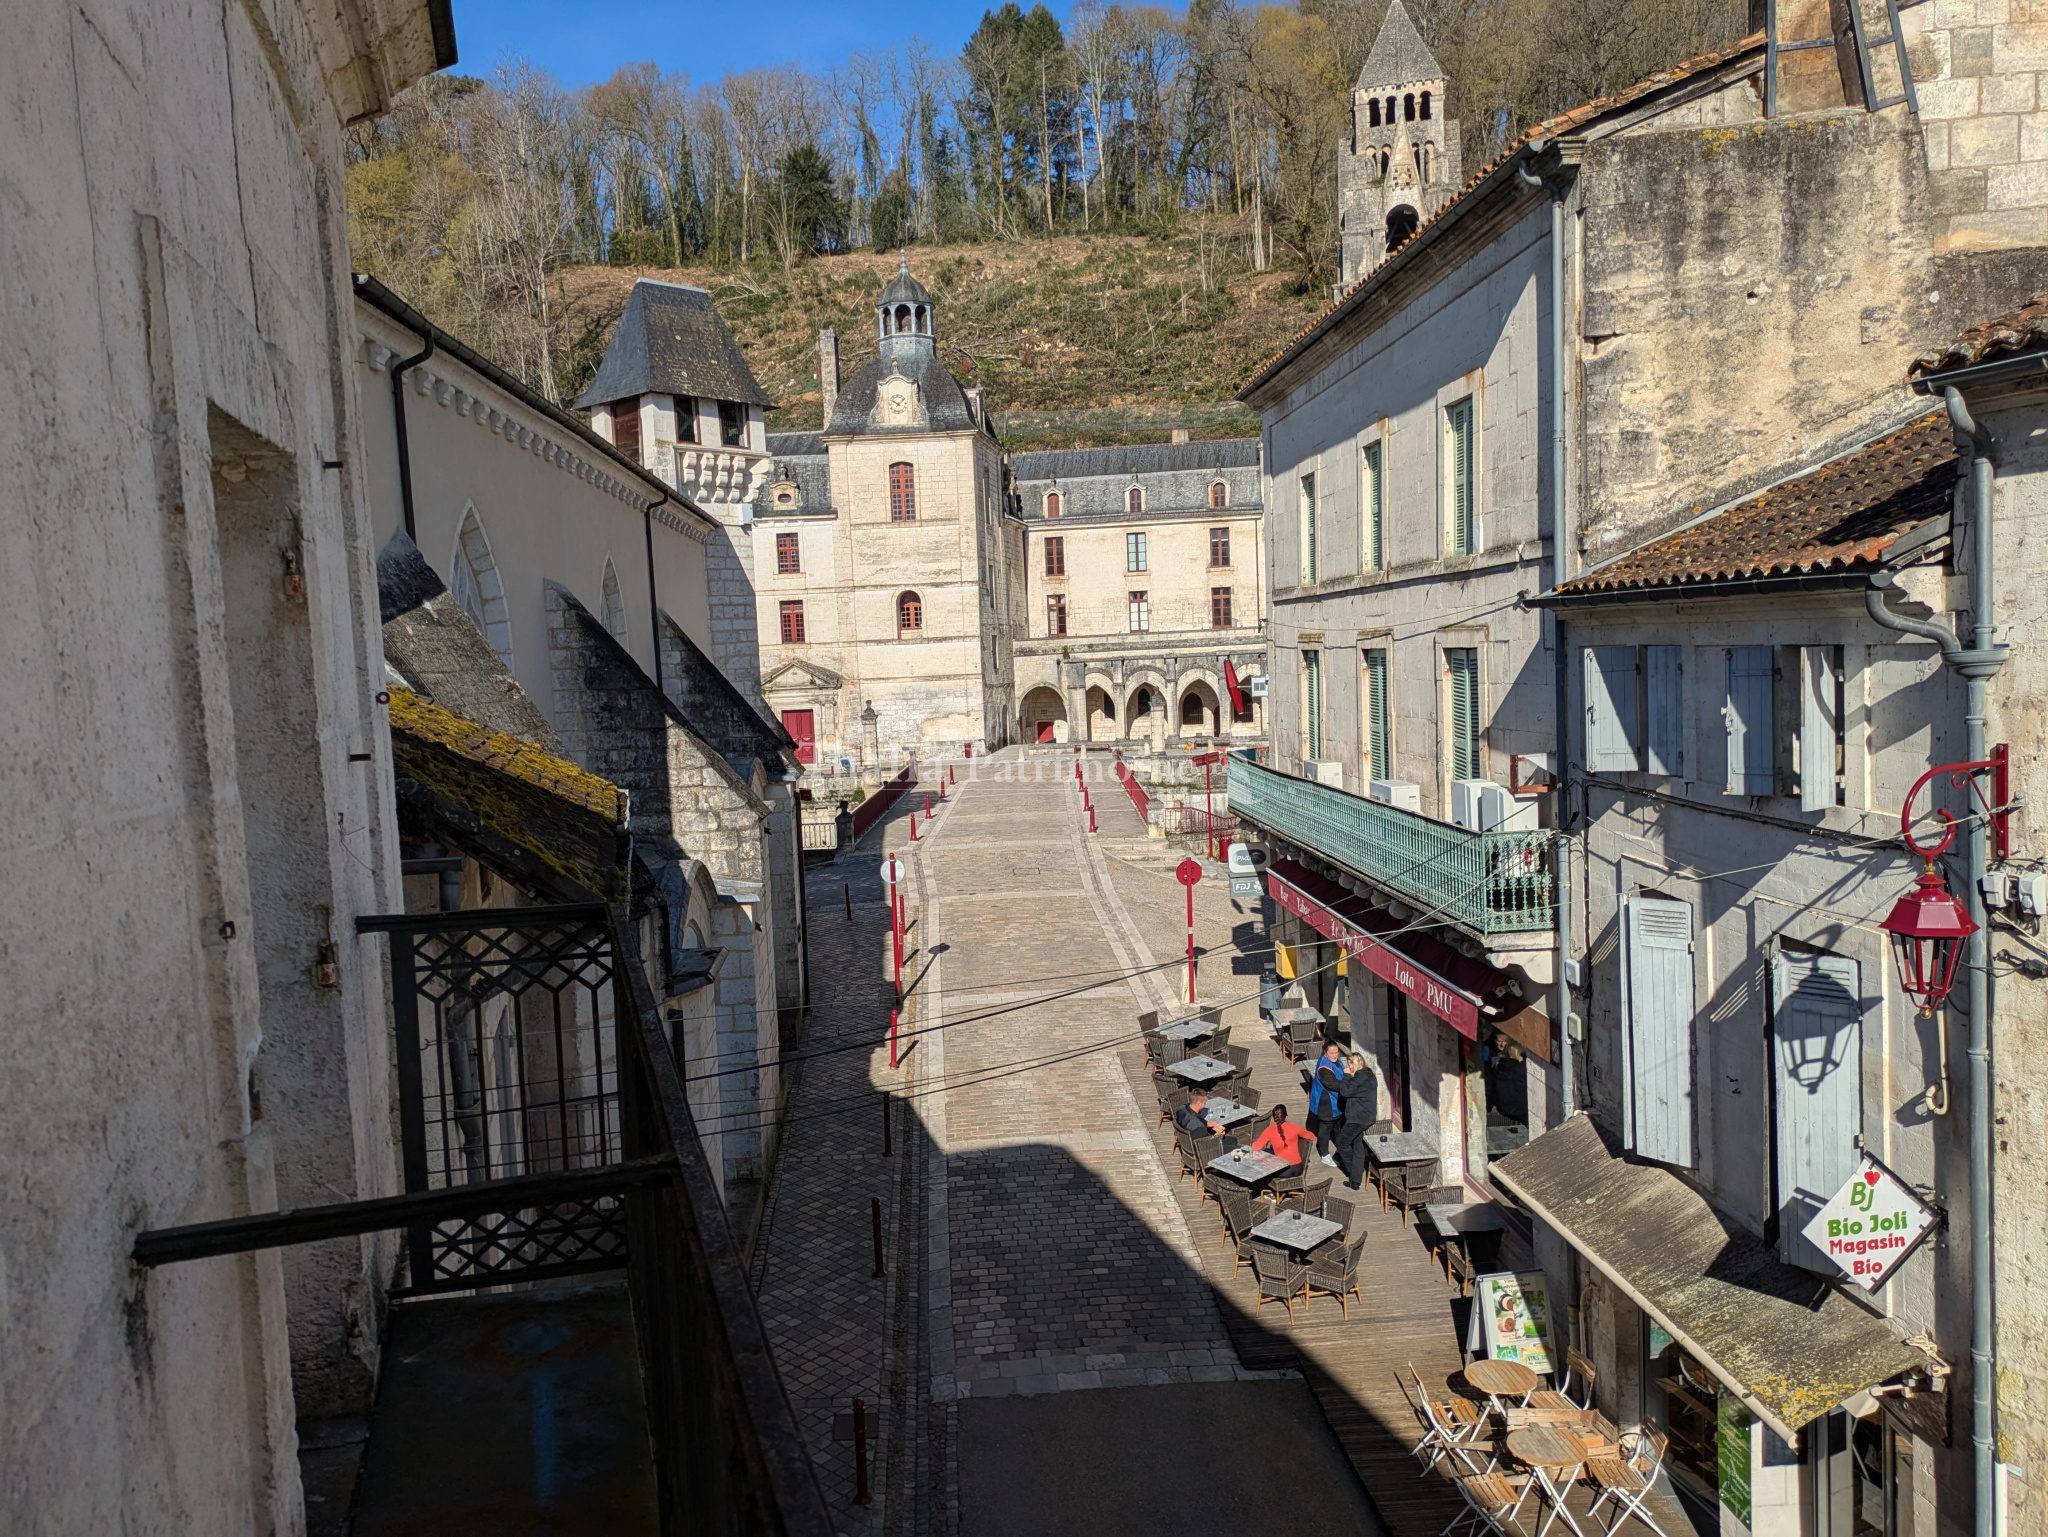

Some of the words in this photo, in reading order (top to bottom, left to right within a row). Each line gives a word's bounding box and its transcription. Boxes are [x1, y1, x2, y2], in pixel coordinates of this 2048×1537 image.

[1235, 883, 1251, 891] FDJ
[1394, 961, 1415, 990] Loto
[1426, 981, 1454, 1015] PMU
[1827, 1218, 1862, 1237] Bio
[1869, 1211, 1908, 1233] Joli
[1829, 1233, 1905, 1255] Magasin
[1853, 1259, 1883, 1275] Bio
